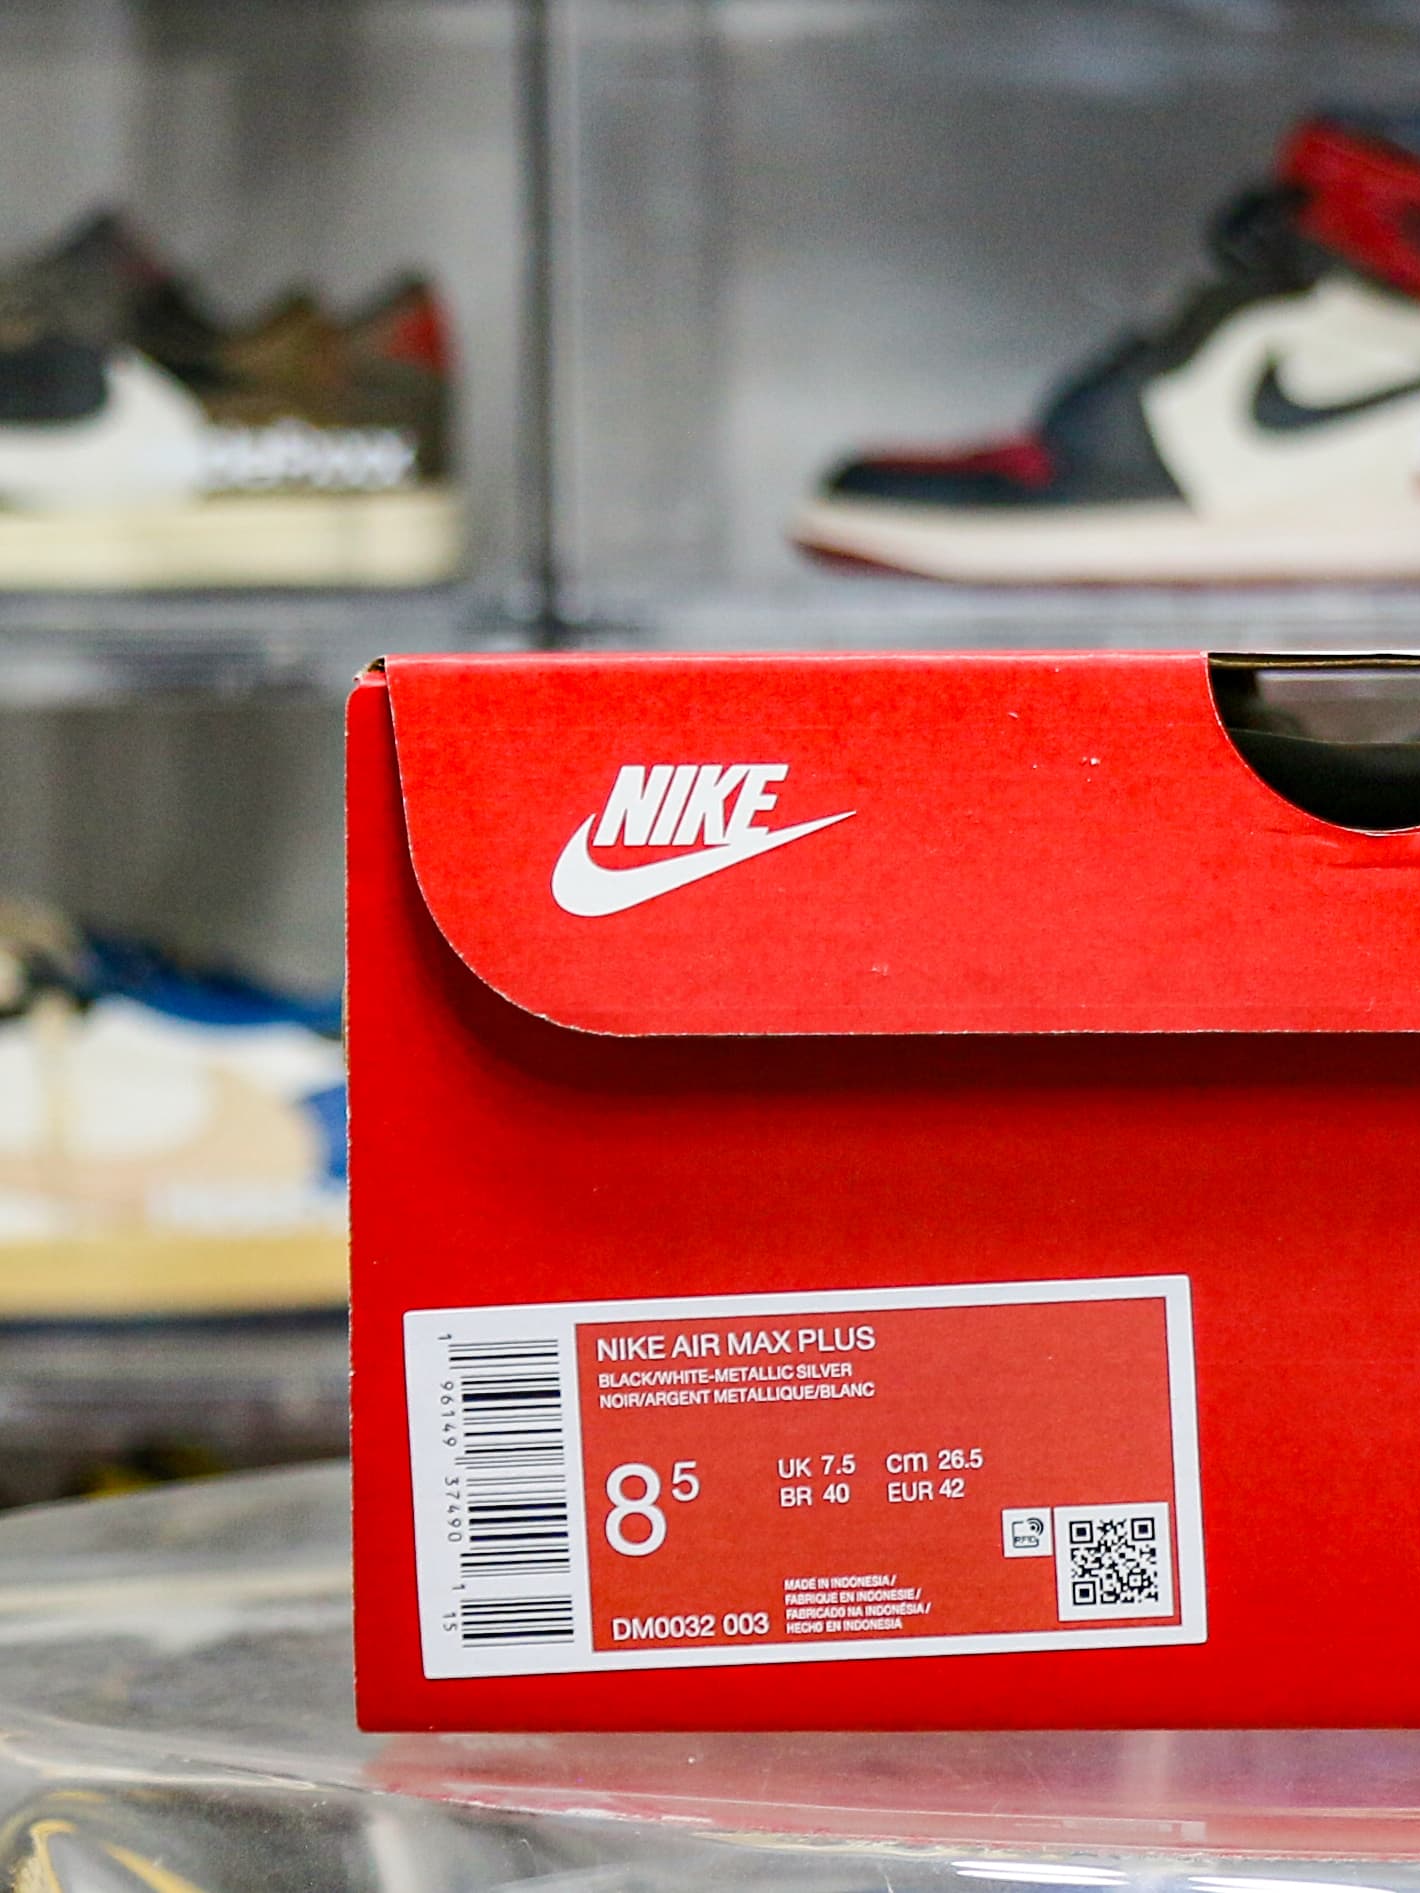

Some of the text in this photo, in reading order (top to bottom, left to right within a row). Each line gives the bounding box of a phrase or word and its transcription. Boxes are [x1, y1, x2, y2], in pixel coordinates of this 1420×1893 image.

[592, 763, 789, 847] NIKE
[597, 1326, 876, 1361] NIKE AIR MAX PLUS
[598, 1363, 852, 1388] BLACK/WHITE-METALLIC SILVER
[599, 1382, 875, 1409] NOIR/ARGENT METALLIQUE/BLANC
[440, 1380, 457, 1447] 96149
[777, 1454, 856, 1479] UK 7.5
[938, 1448, 984, 1470] 26.5
[780, 1483, 850, 1507] BR 40
[888, 1478, 965, 1503] EUR 42
[445, 1476, 462, 1542] 37490
[784, 1577, 816, 1591] MADE
[818, 1577, 830, 1589] IN
[839, 1592, 855, 1603] EN
[785, 1606, 845, 1620] FABRICADO
[847, 1606, 864, 1617] NA
[612, 1611, 769, 1641] DM0032 003
[786, 1618, 902, 1634] HECHO EN INDONESIA
